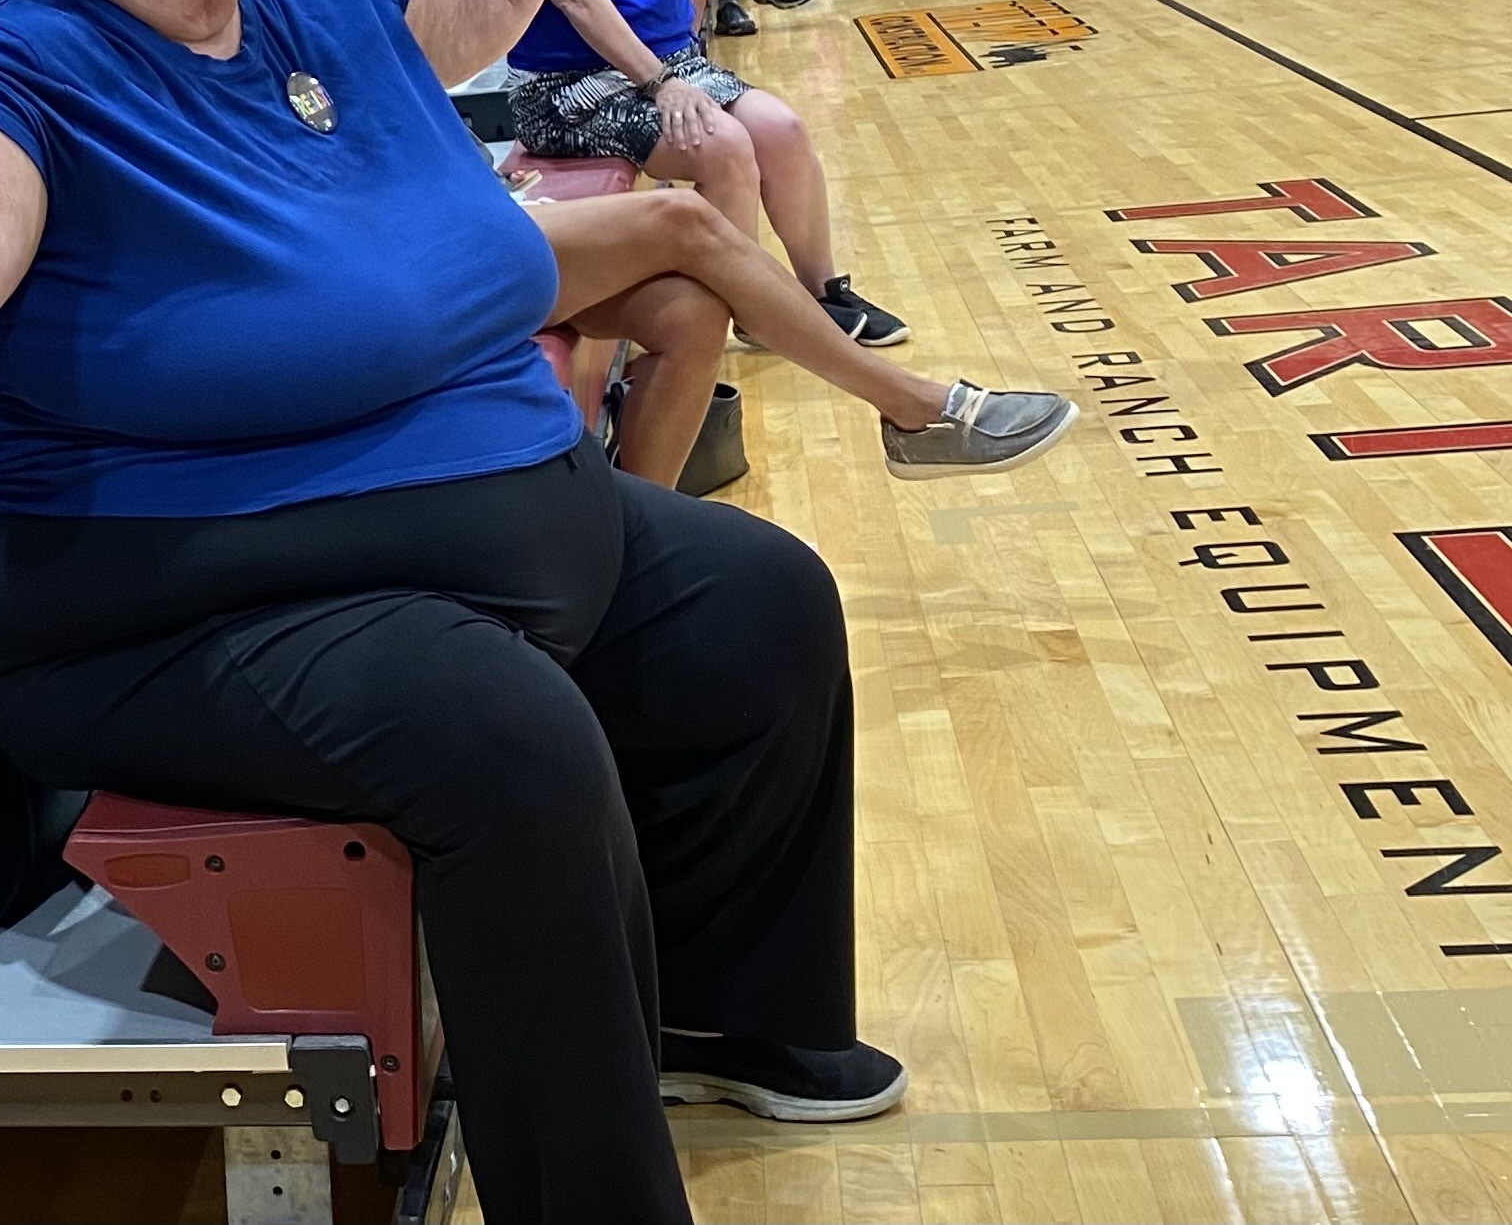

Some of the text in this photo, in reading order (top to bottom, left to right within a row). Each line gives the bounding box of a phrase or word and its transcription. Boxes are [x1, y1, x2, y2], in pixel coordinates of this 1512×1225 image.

[985, 216, 1070, 270] FARM
[1026, 282, 1117, 334] AND
[1071, 350, 1225, 477] RANCH
